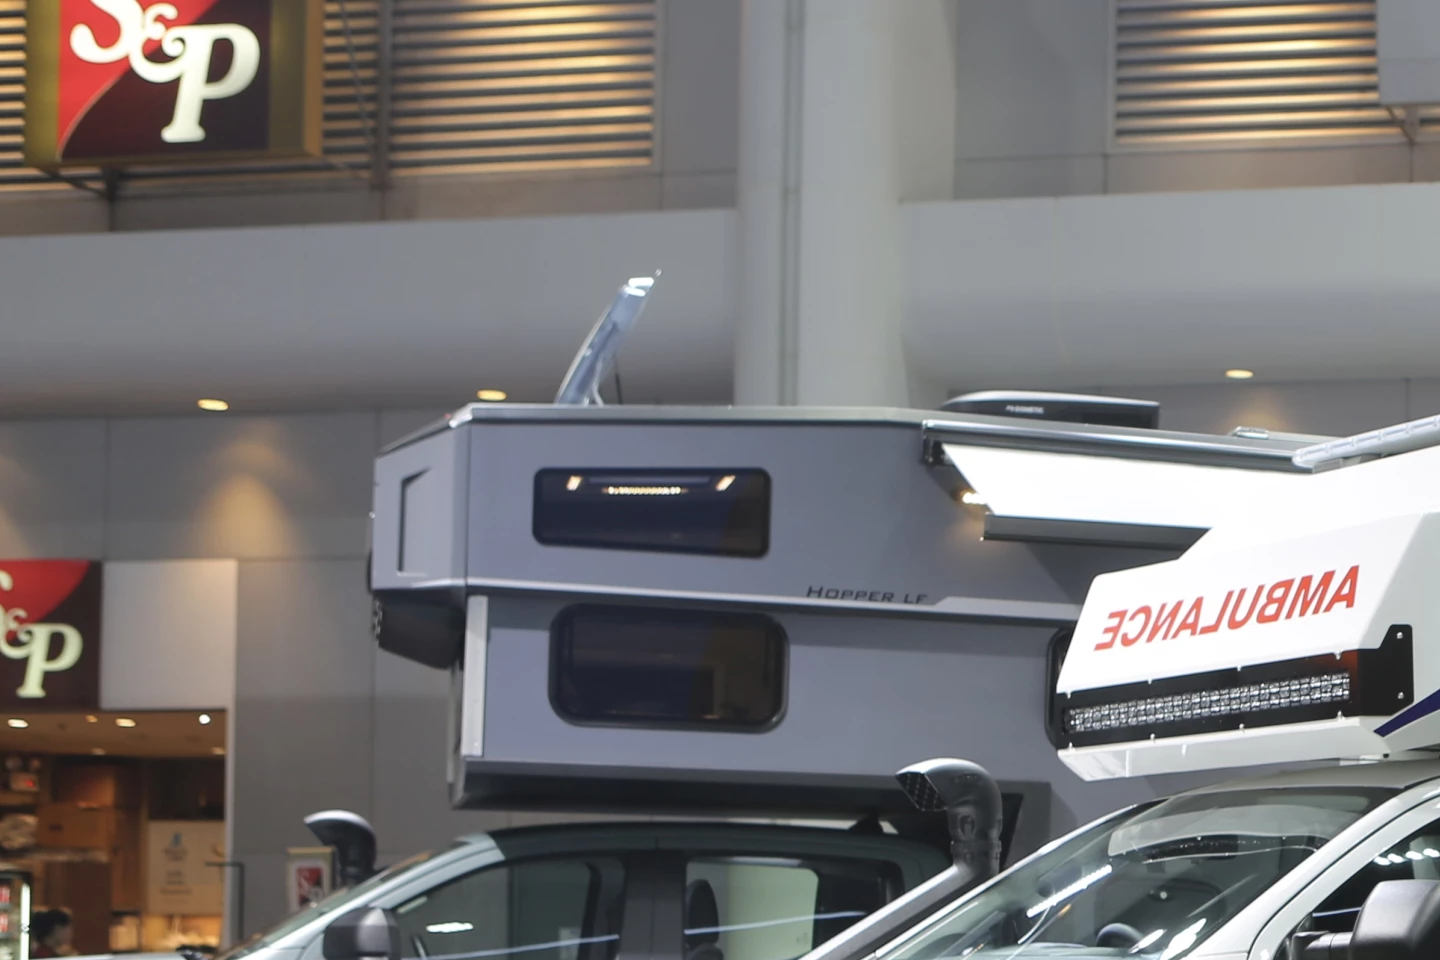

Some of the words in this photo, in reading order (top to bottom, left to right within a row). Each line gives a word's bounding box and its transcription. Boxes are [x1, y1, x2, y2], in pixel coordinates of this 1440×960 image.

[805, 585, 895, 602] HOPPER
[903, 593, 928, 605] LF
[0, 569, 84, 698] &P
